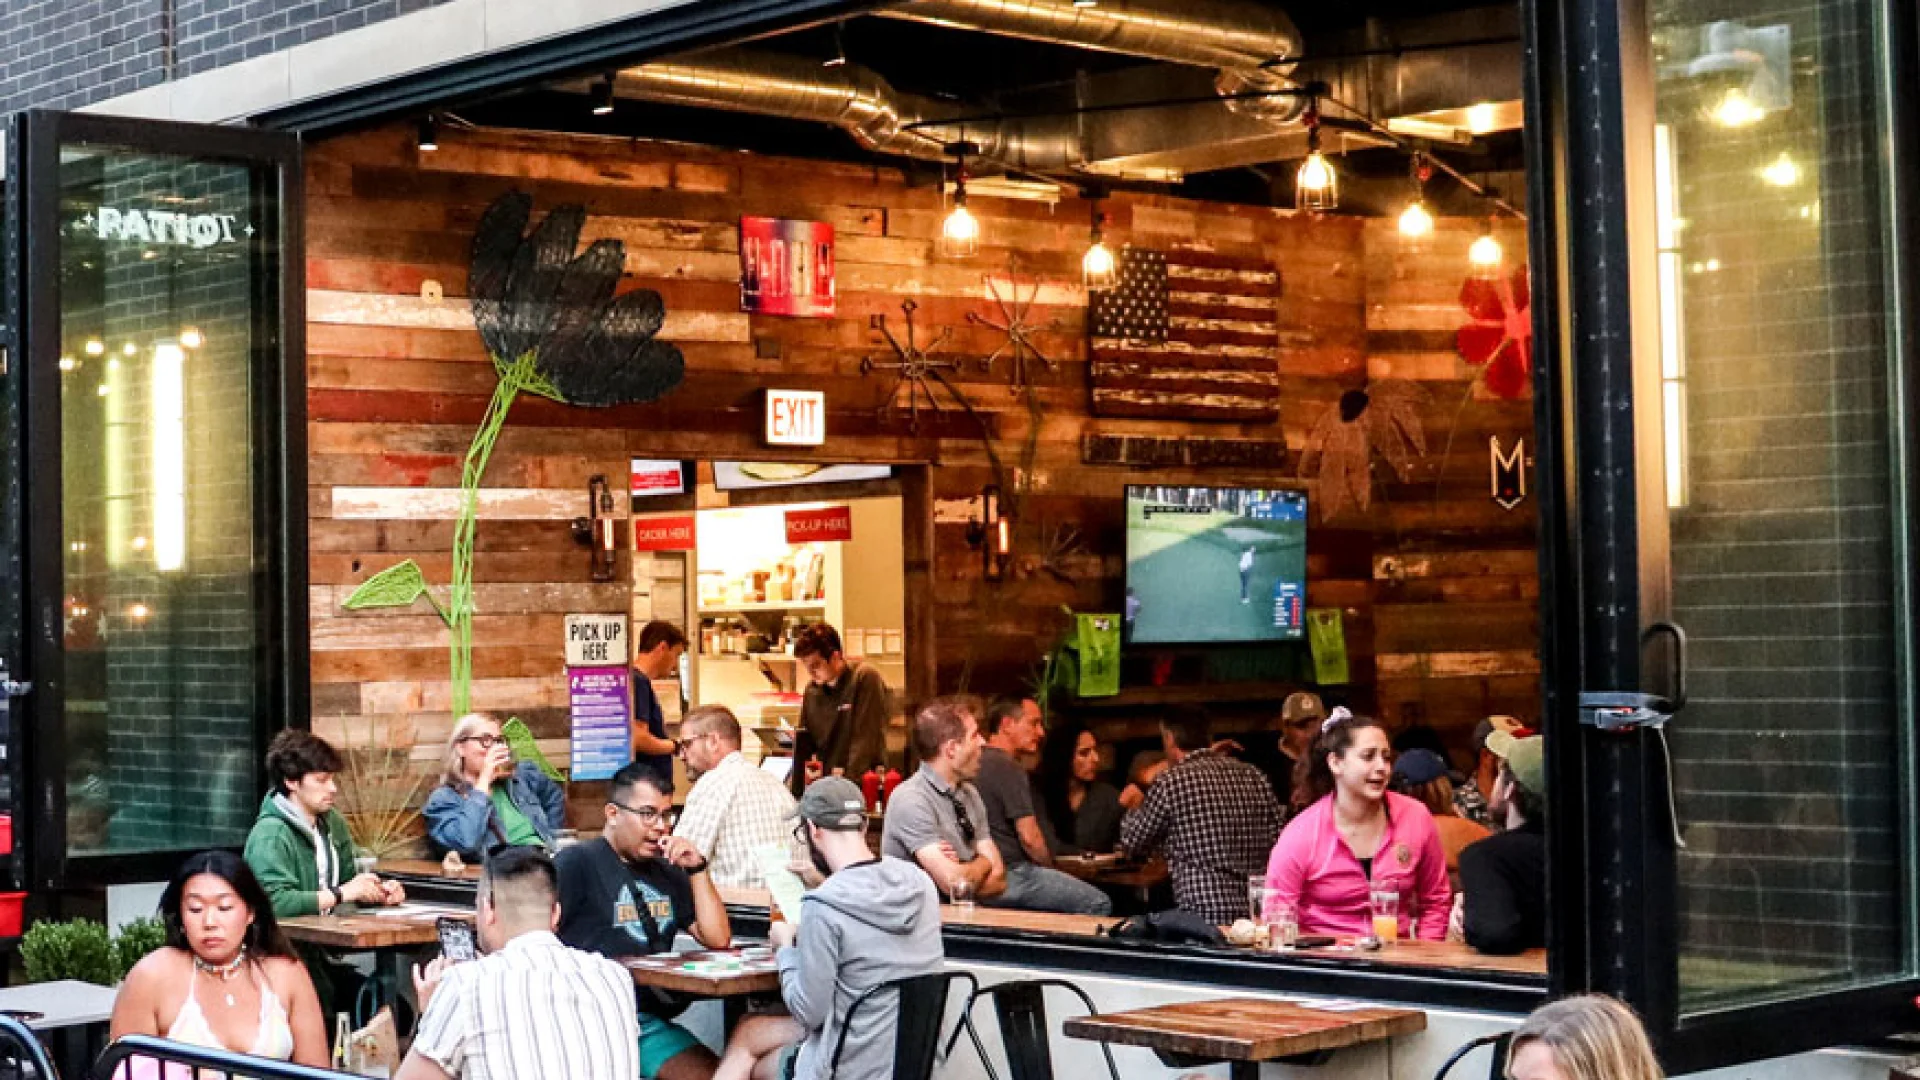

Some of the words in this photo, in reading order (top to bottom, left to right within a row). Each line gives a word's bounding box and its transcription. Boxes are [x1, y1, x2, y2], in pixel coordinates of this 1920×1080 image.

[772, 397, 817, 437] EXIT
[639, 528, 667, 541] ORDER
[668, 526, 690, 540] HERE
[786, 518, 821, 533] PICK-UP
[824, 516, 847, 531] HERE
[570, 623, 600, 641] PICK
[604, 622, 621, 641] UP
[583, 642, 608, 661] HERE
